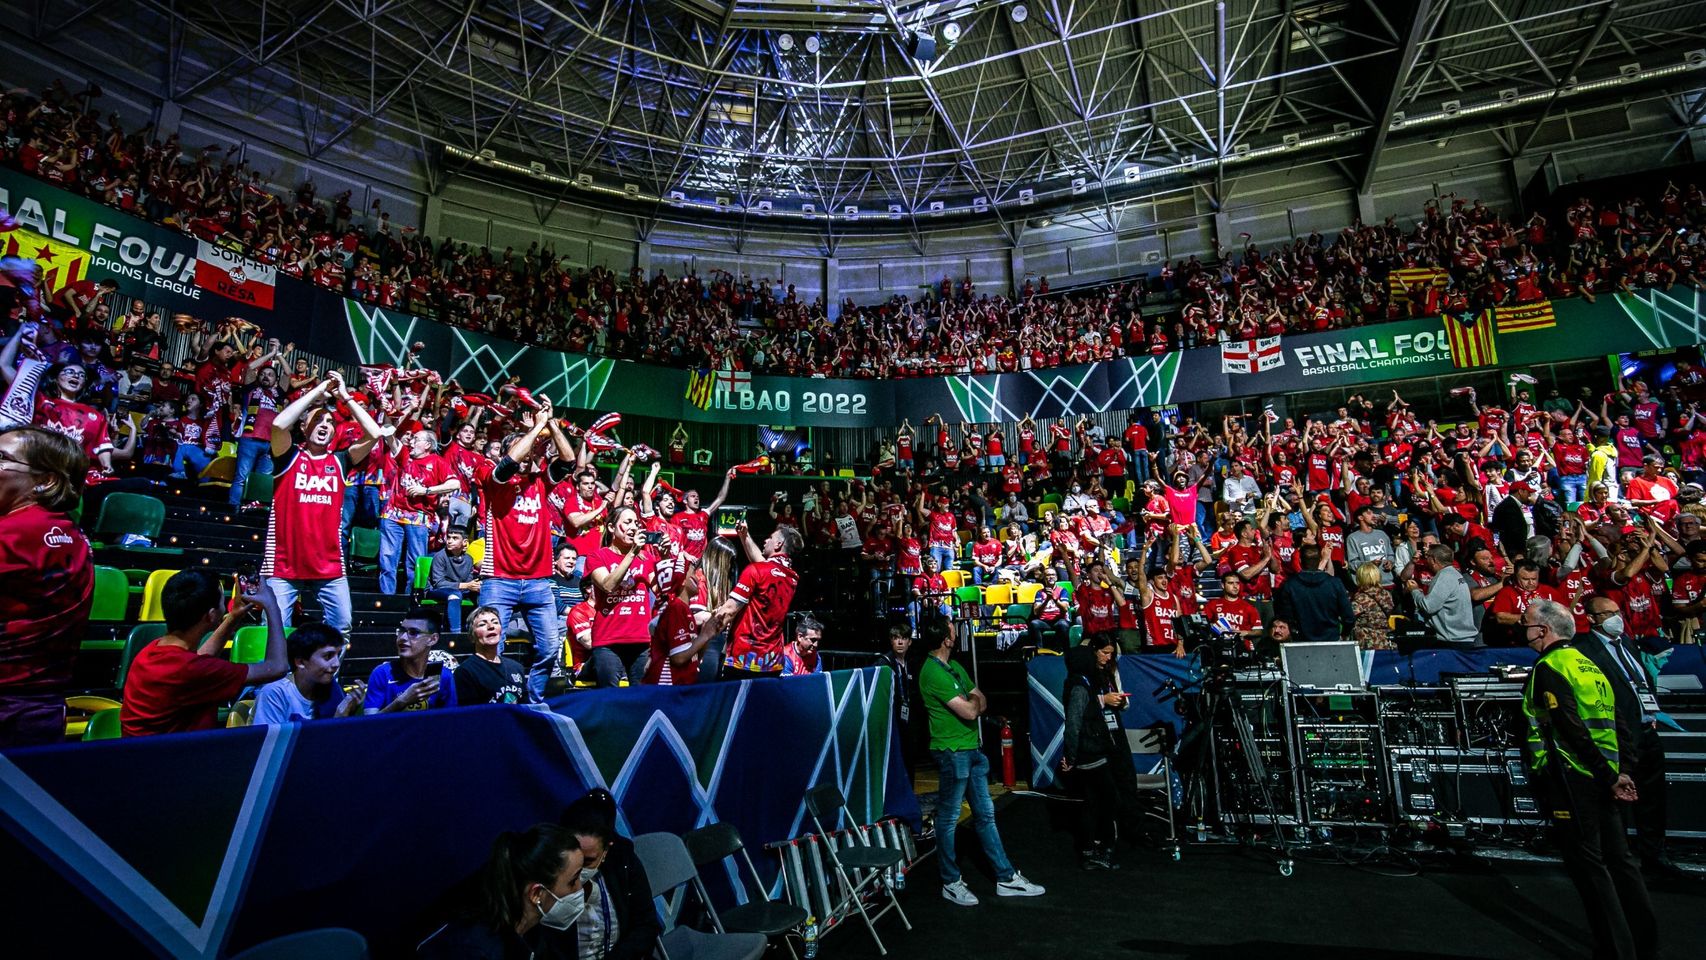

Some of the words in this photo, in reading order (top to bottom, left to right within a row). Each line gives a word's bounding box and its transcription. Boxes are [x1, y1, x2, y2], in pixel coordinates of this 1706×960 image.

[91, 254, 142, 281] PIONS
[144, 273, 201, 301] LEAGUE
[1294, 337, 1389, 368] FINAL
[1302, 361, 1369, 376] BASKETBALL
[1369, 353, 1436, 369] CHAMPIONS
[707, 389, 791, 412] ILBAO
[802, 391, 867, 414] 2022
[606, 595, 645, 604] CONGOST
[1163, 628, 1174, 640] 21
